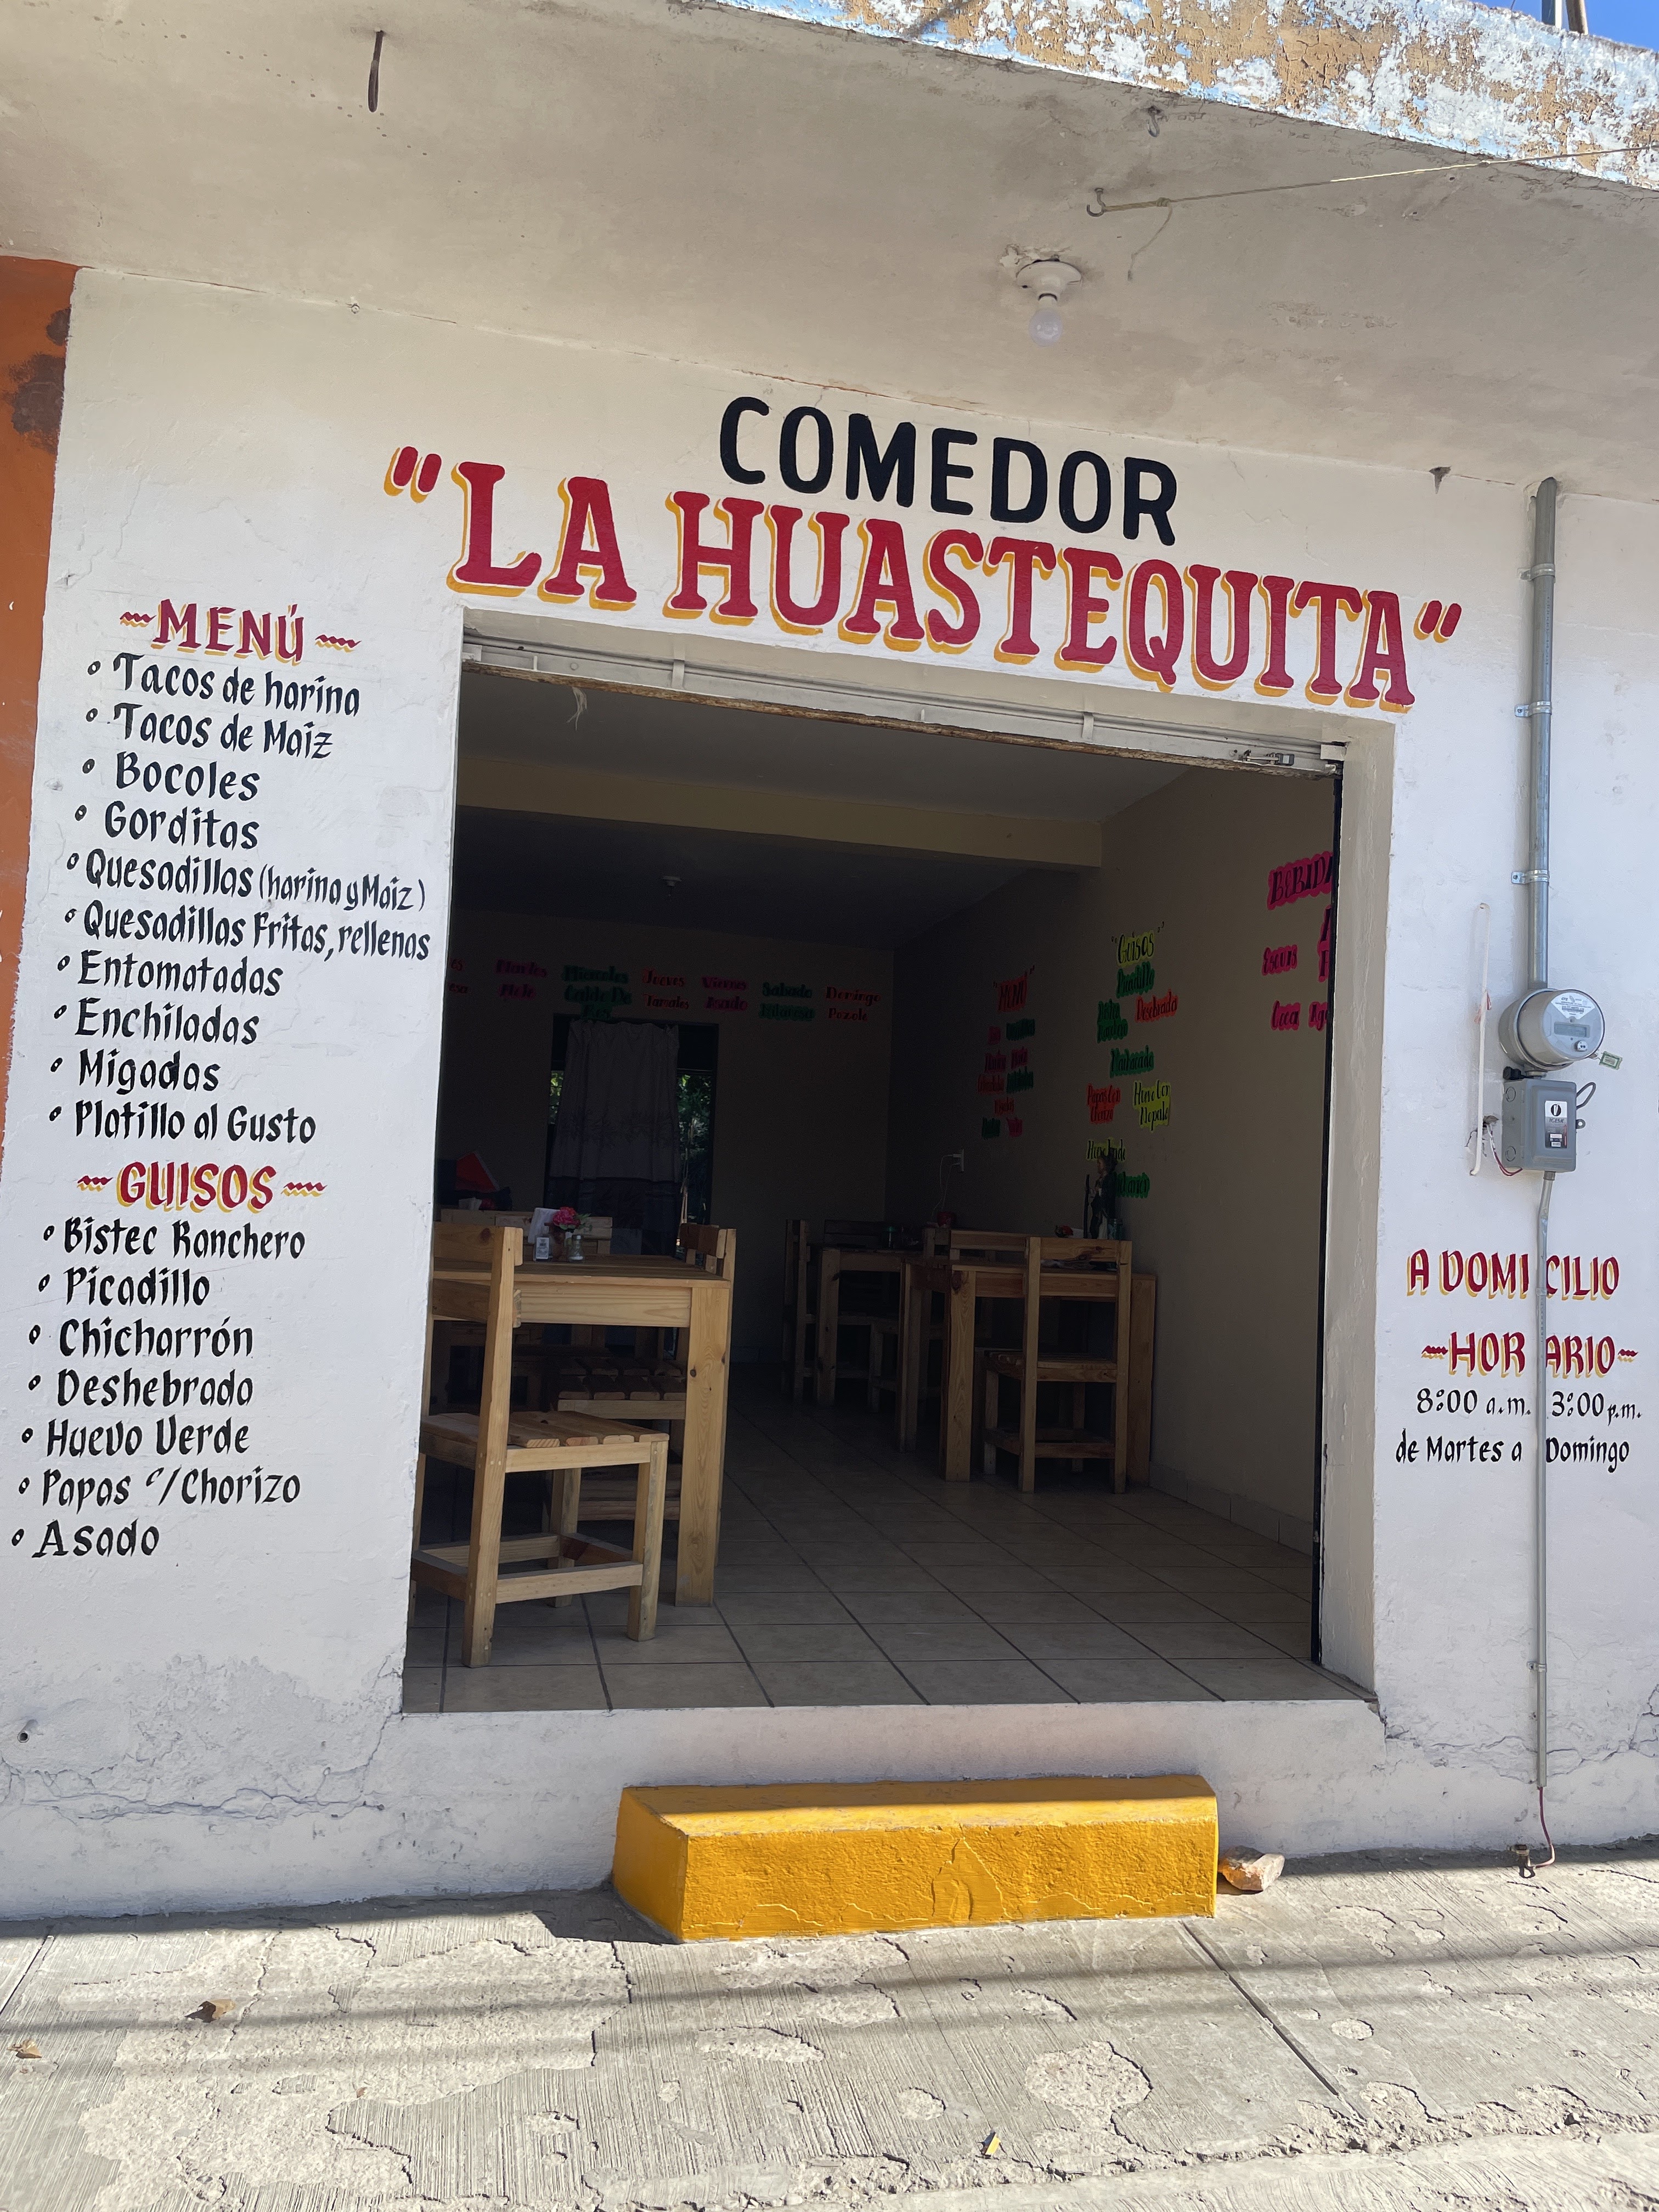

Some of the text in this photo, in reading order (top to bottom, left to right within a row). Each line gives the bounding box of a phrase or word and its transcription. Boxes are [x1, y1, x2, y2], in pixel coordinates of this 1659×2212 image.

[719, 396, 1177, 546] COMEDOR
[149, 600, 303, 665] MENÚ
[114, 653, 359, 716] Tacos de harina
[114, 703, 332, 759] Tacos de Maiz
[117, 752, 259, 801] Bocoles
[105, 801, 259, 850] Gorditas
[87, 849, 253, 896] Quesadillas
[84, 900, 246, 946] Quesadillas
[339, 921, 430, 960] rellenas
[78, 950, 283, 996] Entomatadas
[75, 997, 259, 1045] Enchiladas
[80, 1048, 221, 1094] Migadas
[76, 1100, 315, 1143] Platillo al Gusto
[117, 1162, 276, 1213] GUISOS
[65, 1217, 304, 1259] Bistec Ranchero
[64, 1266, 209, 1306] Picadillo
[1408, 1249, 1429, 1295] A
[60, 1317, 252, 1358] Chicharrón
[1450, 1332, 1615, 1378] HORARIO
[1418, 1389, 1477, 1414] 8:00
[1487, 1397, 1531, 1415] a.m.
[1552, 1391, 1604, 1417] 3:00
[47, 1414, 249, 1457] Huevo Verde
[1396, 1429, 1629, 1472] de Martes a Domingo
[43, 1469, 131, 1514] Papas
[32, 1519, 159, 1558] Asado
